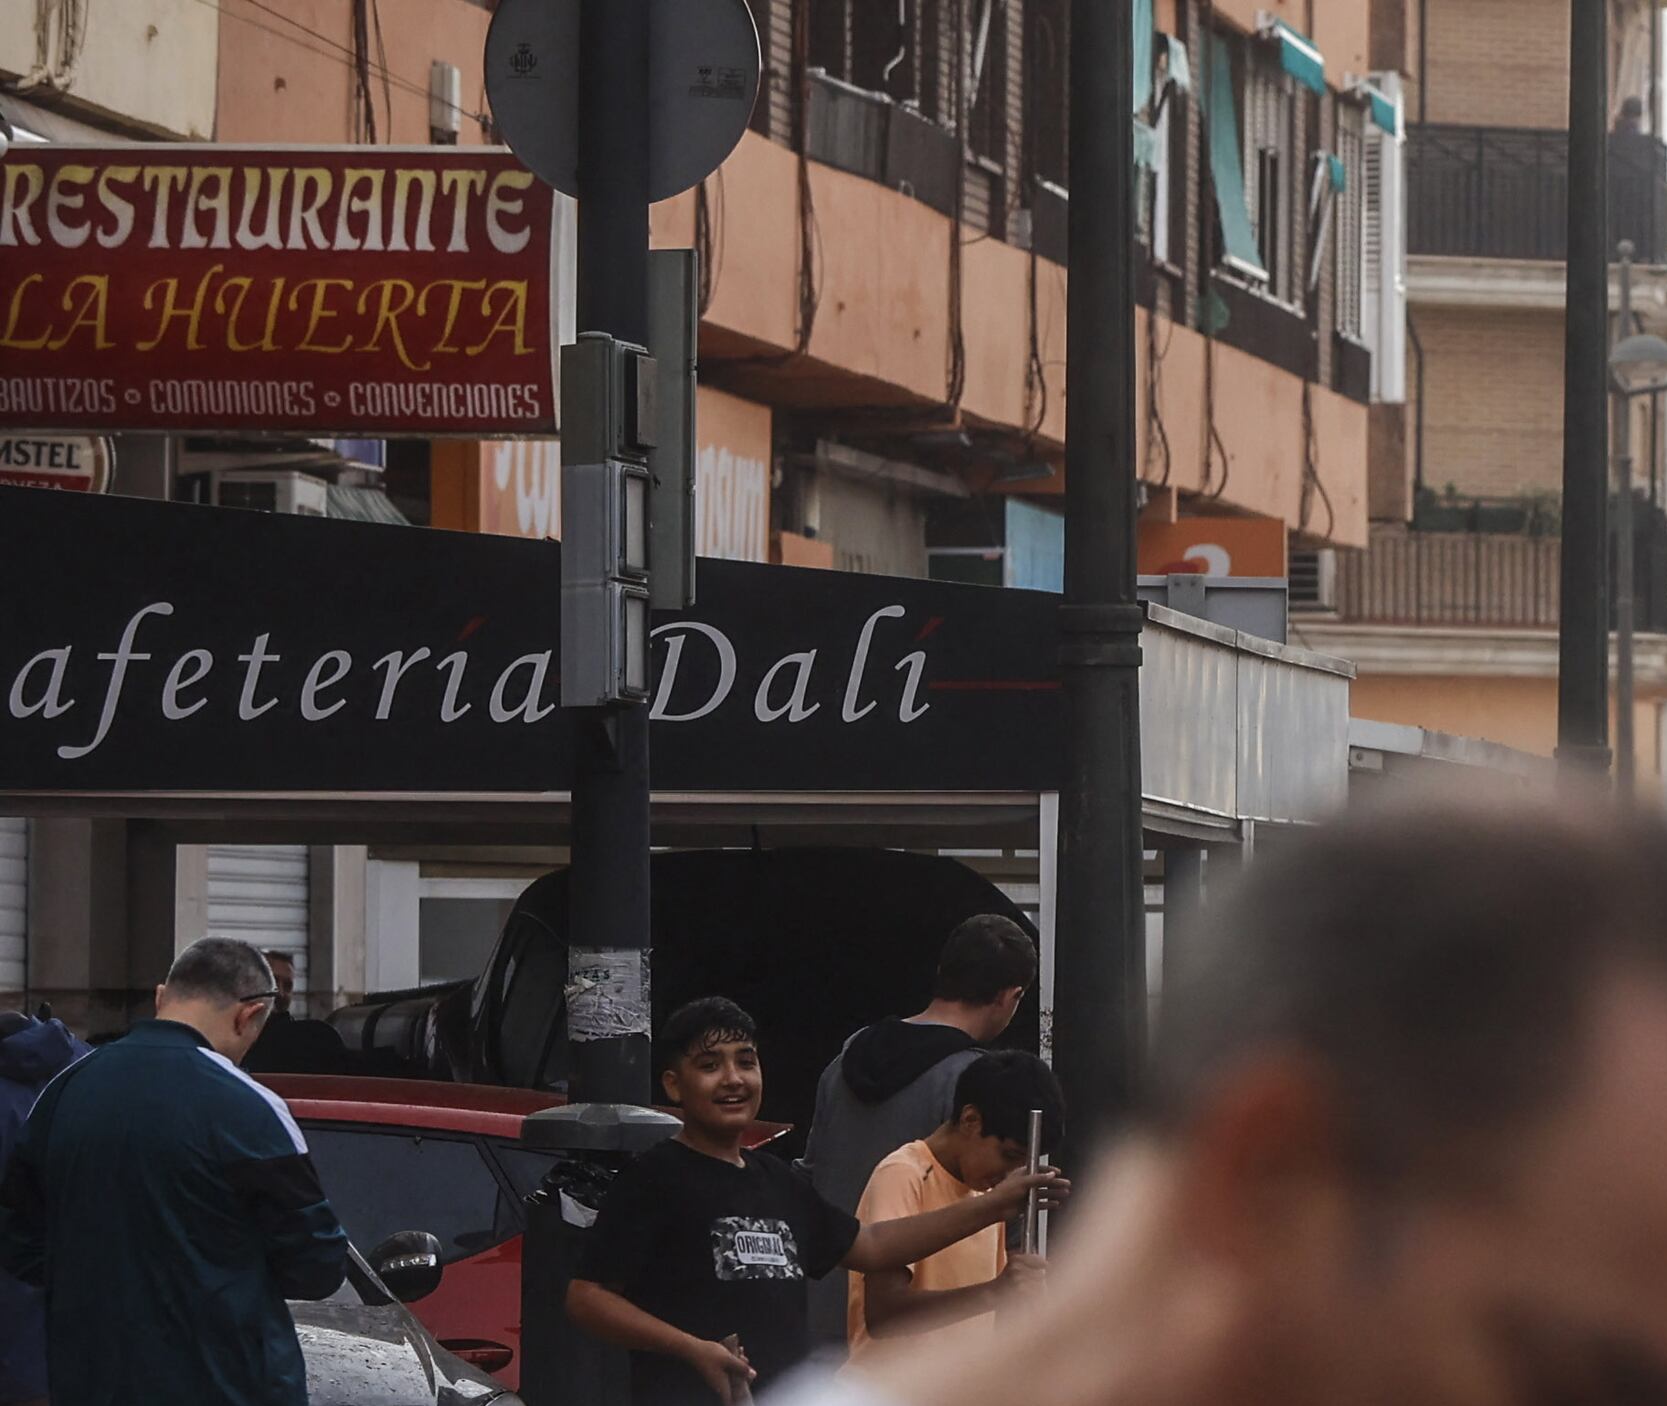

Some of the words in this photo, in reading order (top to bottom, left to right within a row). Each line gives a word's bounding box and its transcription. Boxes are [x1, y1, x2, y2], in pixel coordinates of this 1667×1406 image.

[0, 163, 535, 253] RESTAURANTE
[0, 273, 117, 350] LA
[136, 264, 536, 371] HUERTA
[151, 378, 316, 416] COMUNIONES
[350, 381, 540, 418] CONVENCIONES
